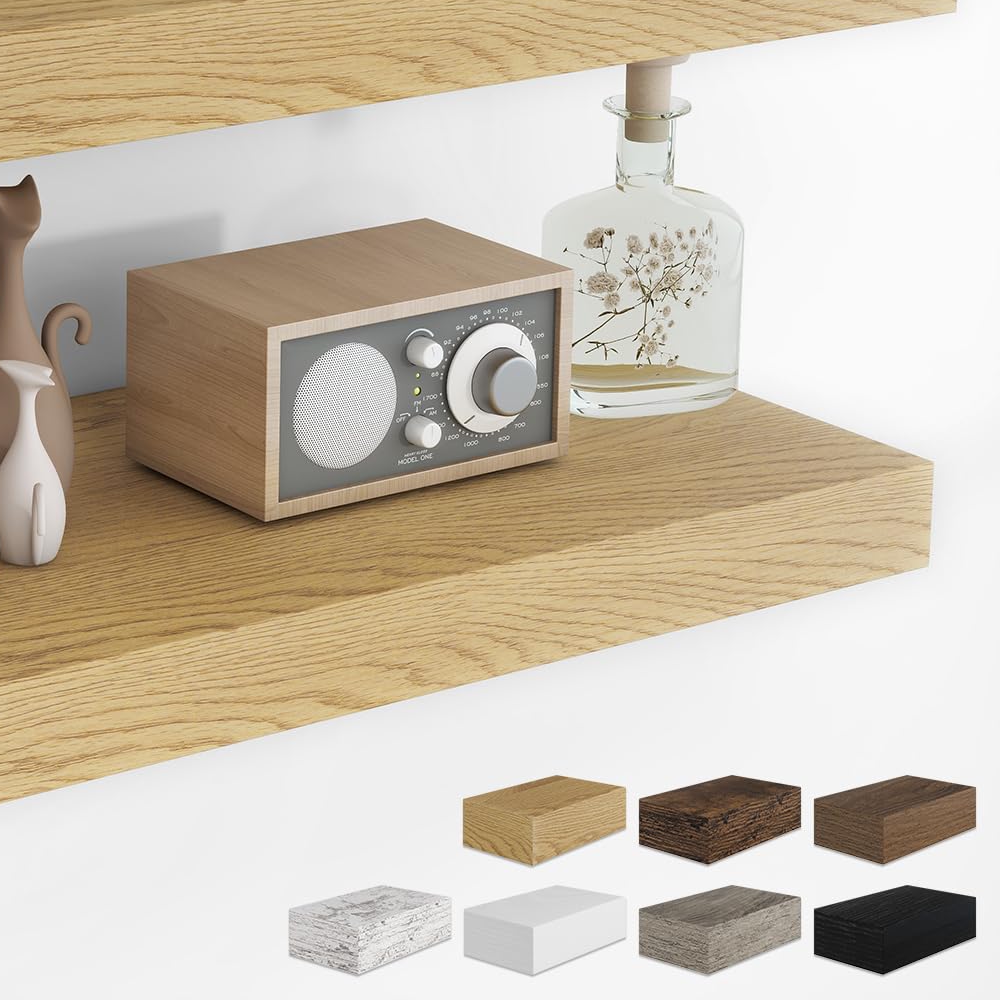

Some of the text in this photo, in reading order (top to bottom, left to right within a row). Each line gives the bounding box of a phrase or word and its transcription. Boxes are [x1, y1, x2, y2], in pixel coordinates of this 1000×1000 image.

[423, 393, 438, 401] 1700
[444, 433, 460, 441] 1200
[397, 452, 433, 465] MODEL ONE
